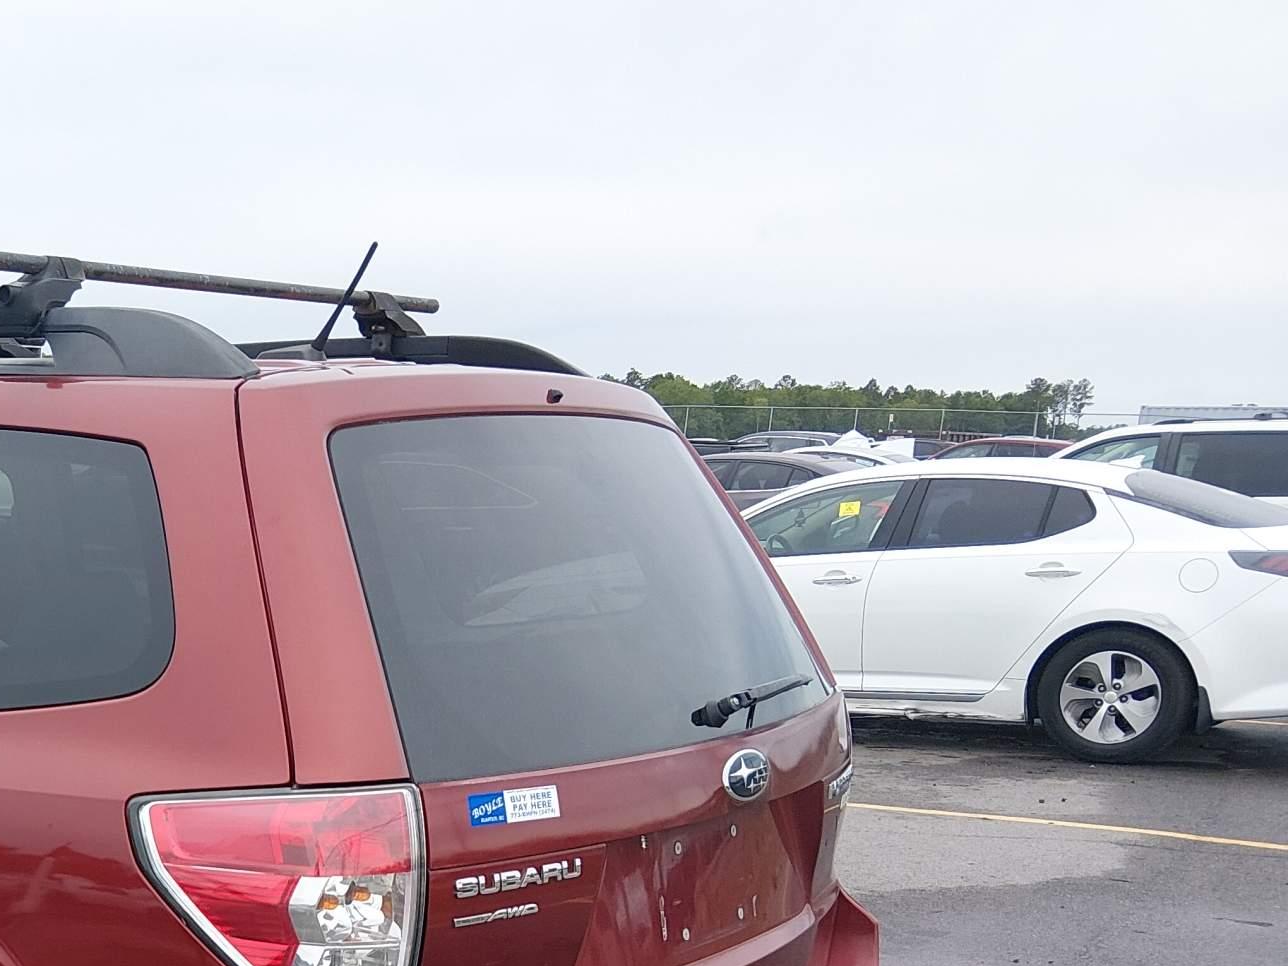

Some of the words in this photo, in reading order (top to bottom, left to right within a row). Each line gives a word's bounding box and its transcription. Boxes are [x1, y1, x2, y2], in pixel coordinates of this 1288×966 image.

[510, 793, 527, 803] BUY
[530, 791, 552, 800] HERE
[513, 803, 528, 812] PAY
[531, 800, 552, 809] HERE
[472, 796, 504, 819] BOYLE
[455, 857, 582, 899] SUBARU
[487, 903, 539, 922] AWD
